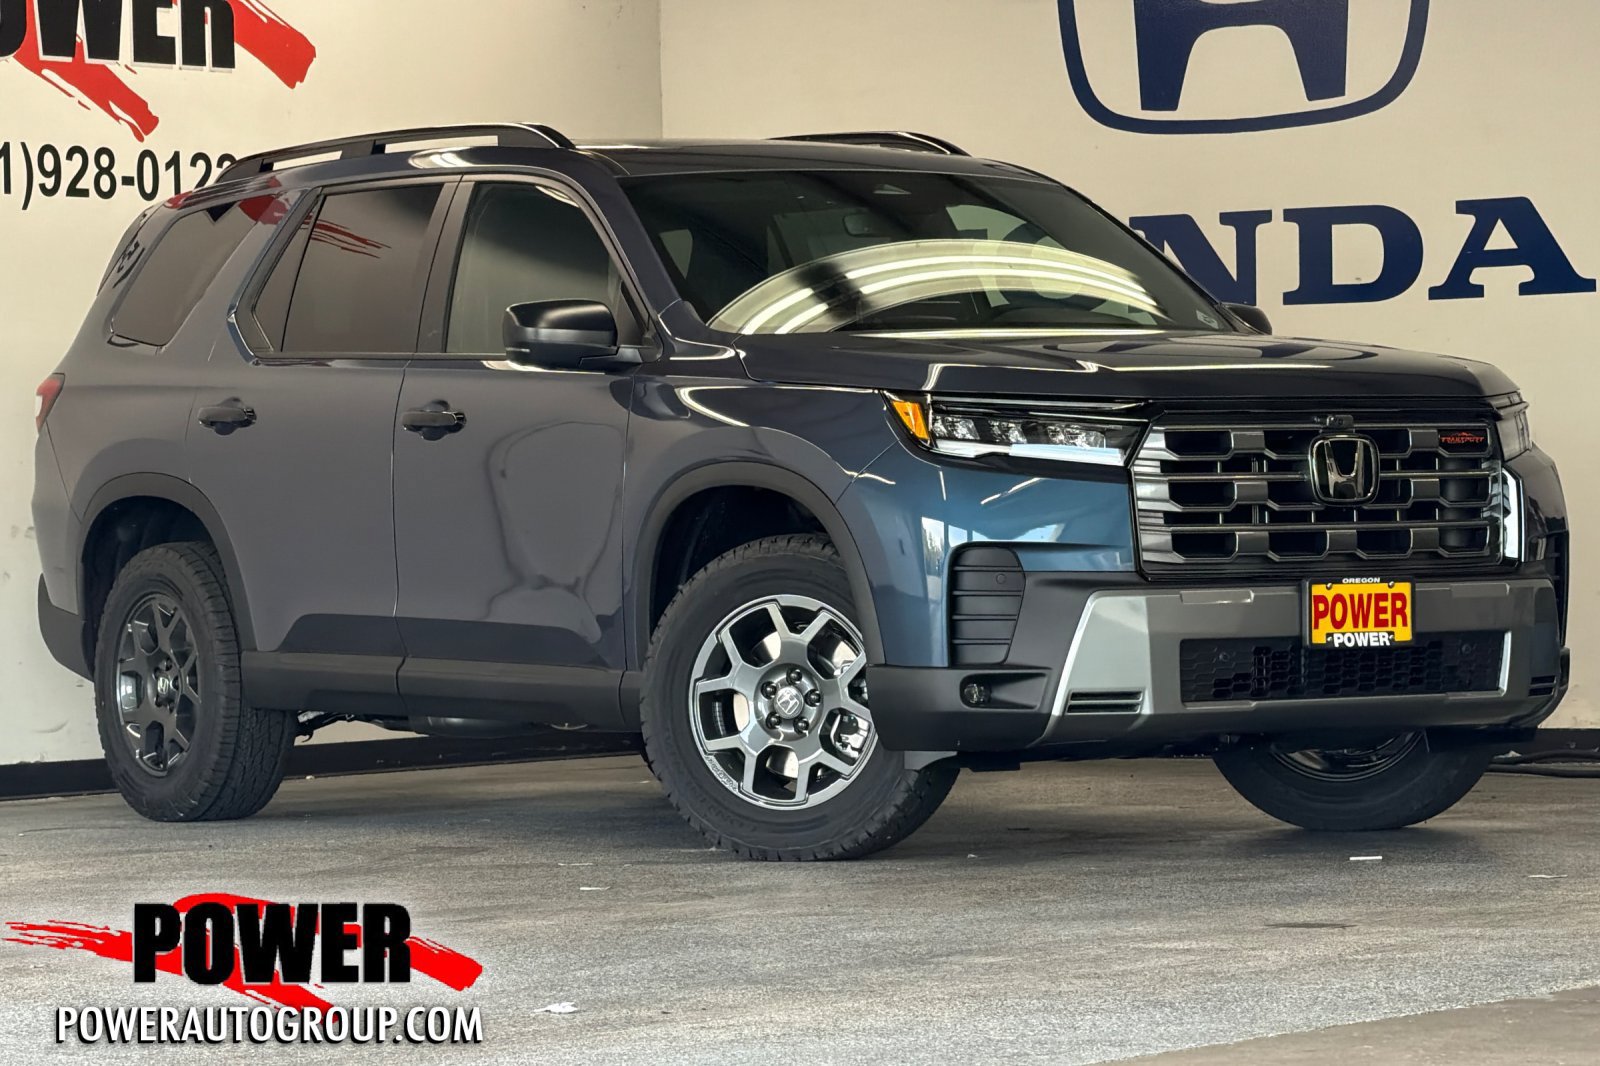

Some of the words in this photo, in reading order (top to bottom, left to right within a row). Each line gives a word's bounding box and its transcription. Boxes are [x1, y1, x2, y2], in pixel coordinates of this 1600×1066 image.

[0, 0, 235, 69] WER
[1129, 196, 1597, 306] NDA
[1313, 592, 1408, 630] POWER
[1333, 632, 1390, 648] POWER
